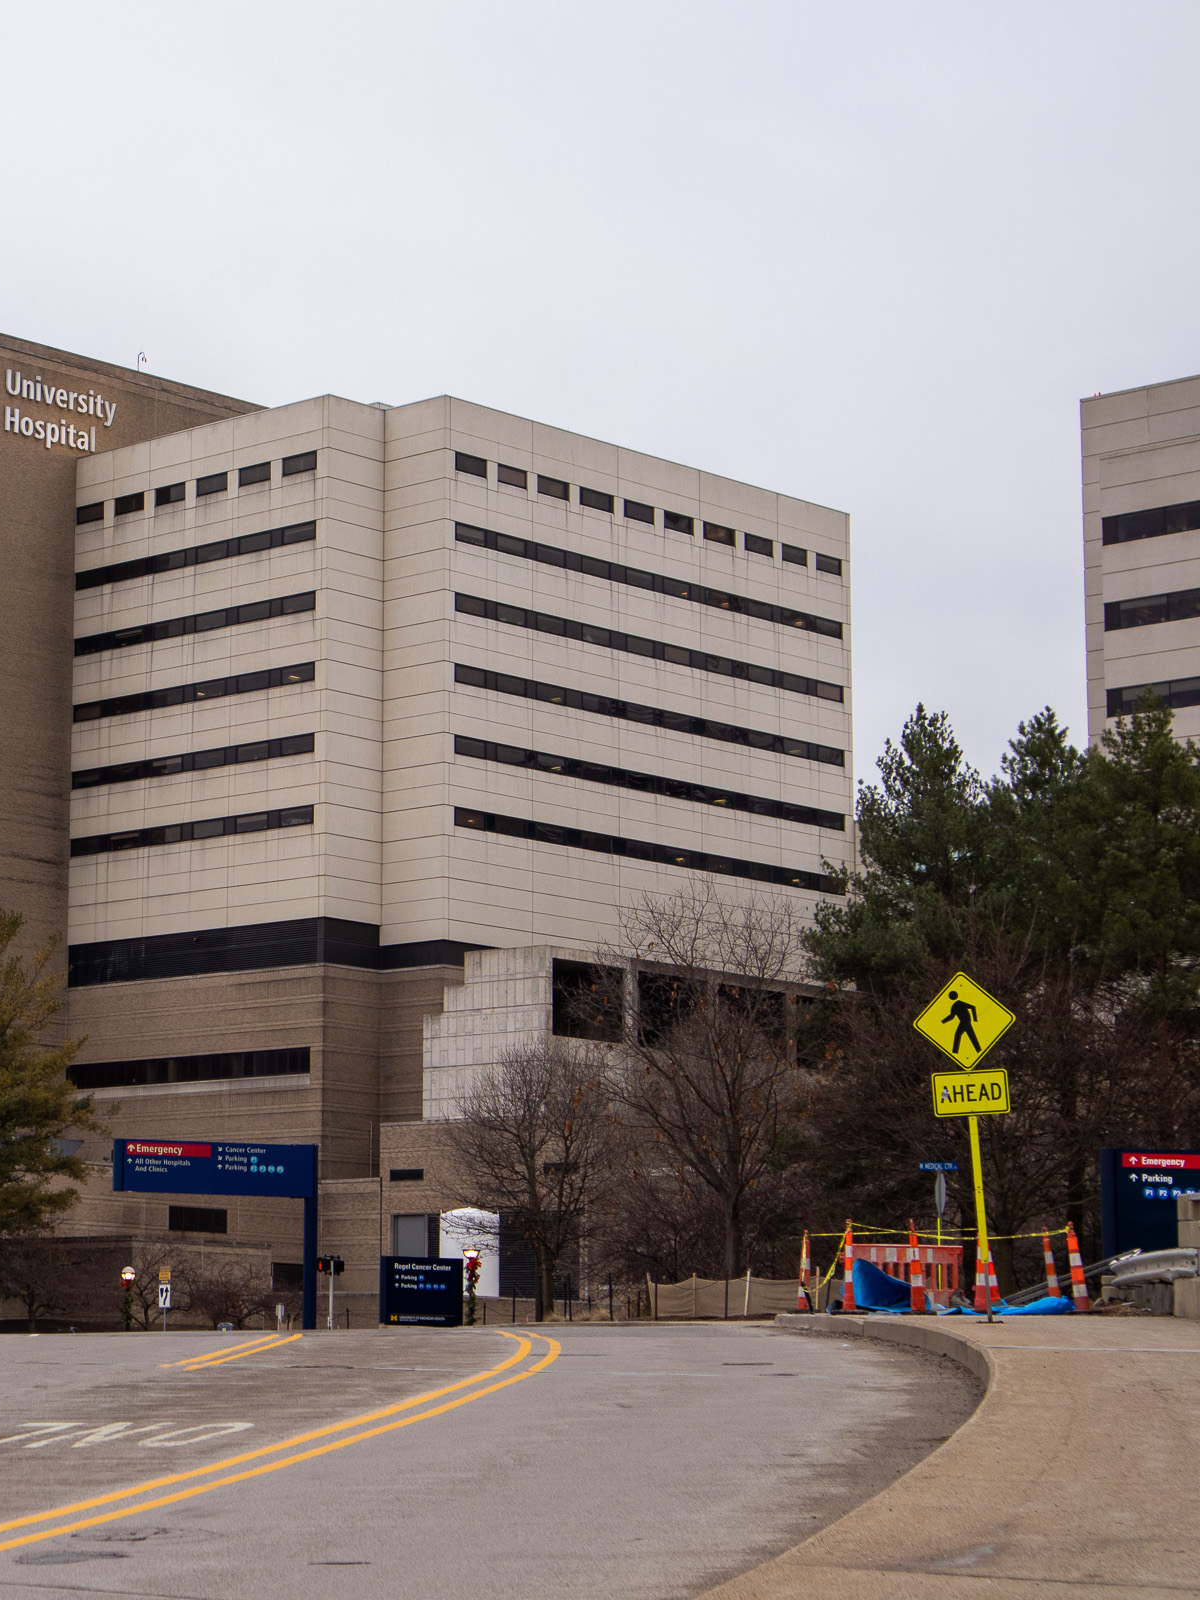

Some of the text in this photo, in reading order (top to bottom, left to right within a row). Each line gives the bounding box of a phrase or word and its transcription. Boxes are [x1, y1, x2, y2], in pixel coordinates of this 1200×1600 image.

[5, 368, 117, 427] University
[4, 406, 96, 452] Hospital
[941, 1083, 1002, 1103] AHEAD
[136, 1144, 183, 1156] Emergency
[225, 1155, 248, 1164] Parking
[1141, 1156, 1186, 1168] Emergency
[225, 1164, 248, 1173] Parking
[1142, 1173, 1173, 1185] Parking
[1159, 1189, 1168, 1197] P2
[394, 1262, 411, 1271] Rogel
